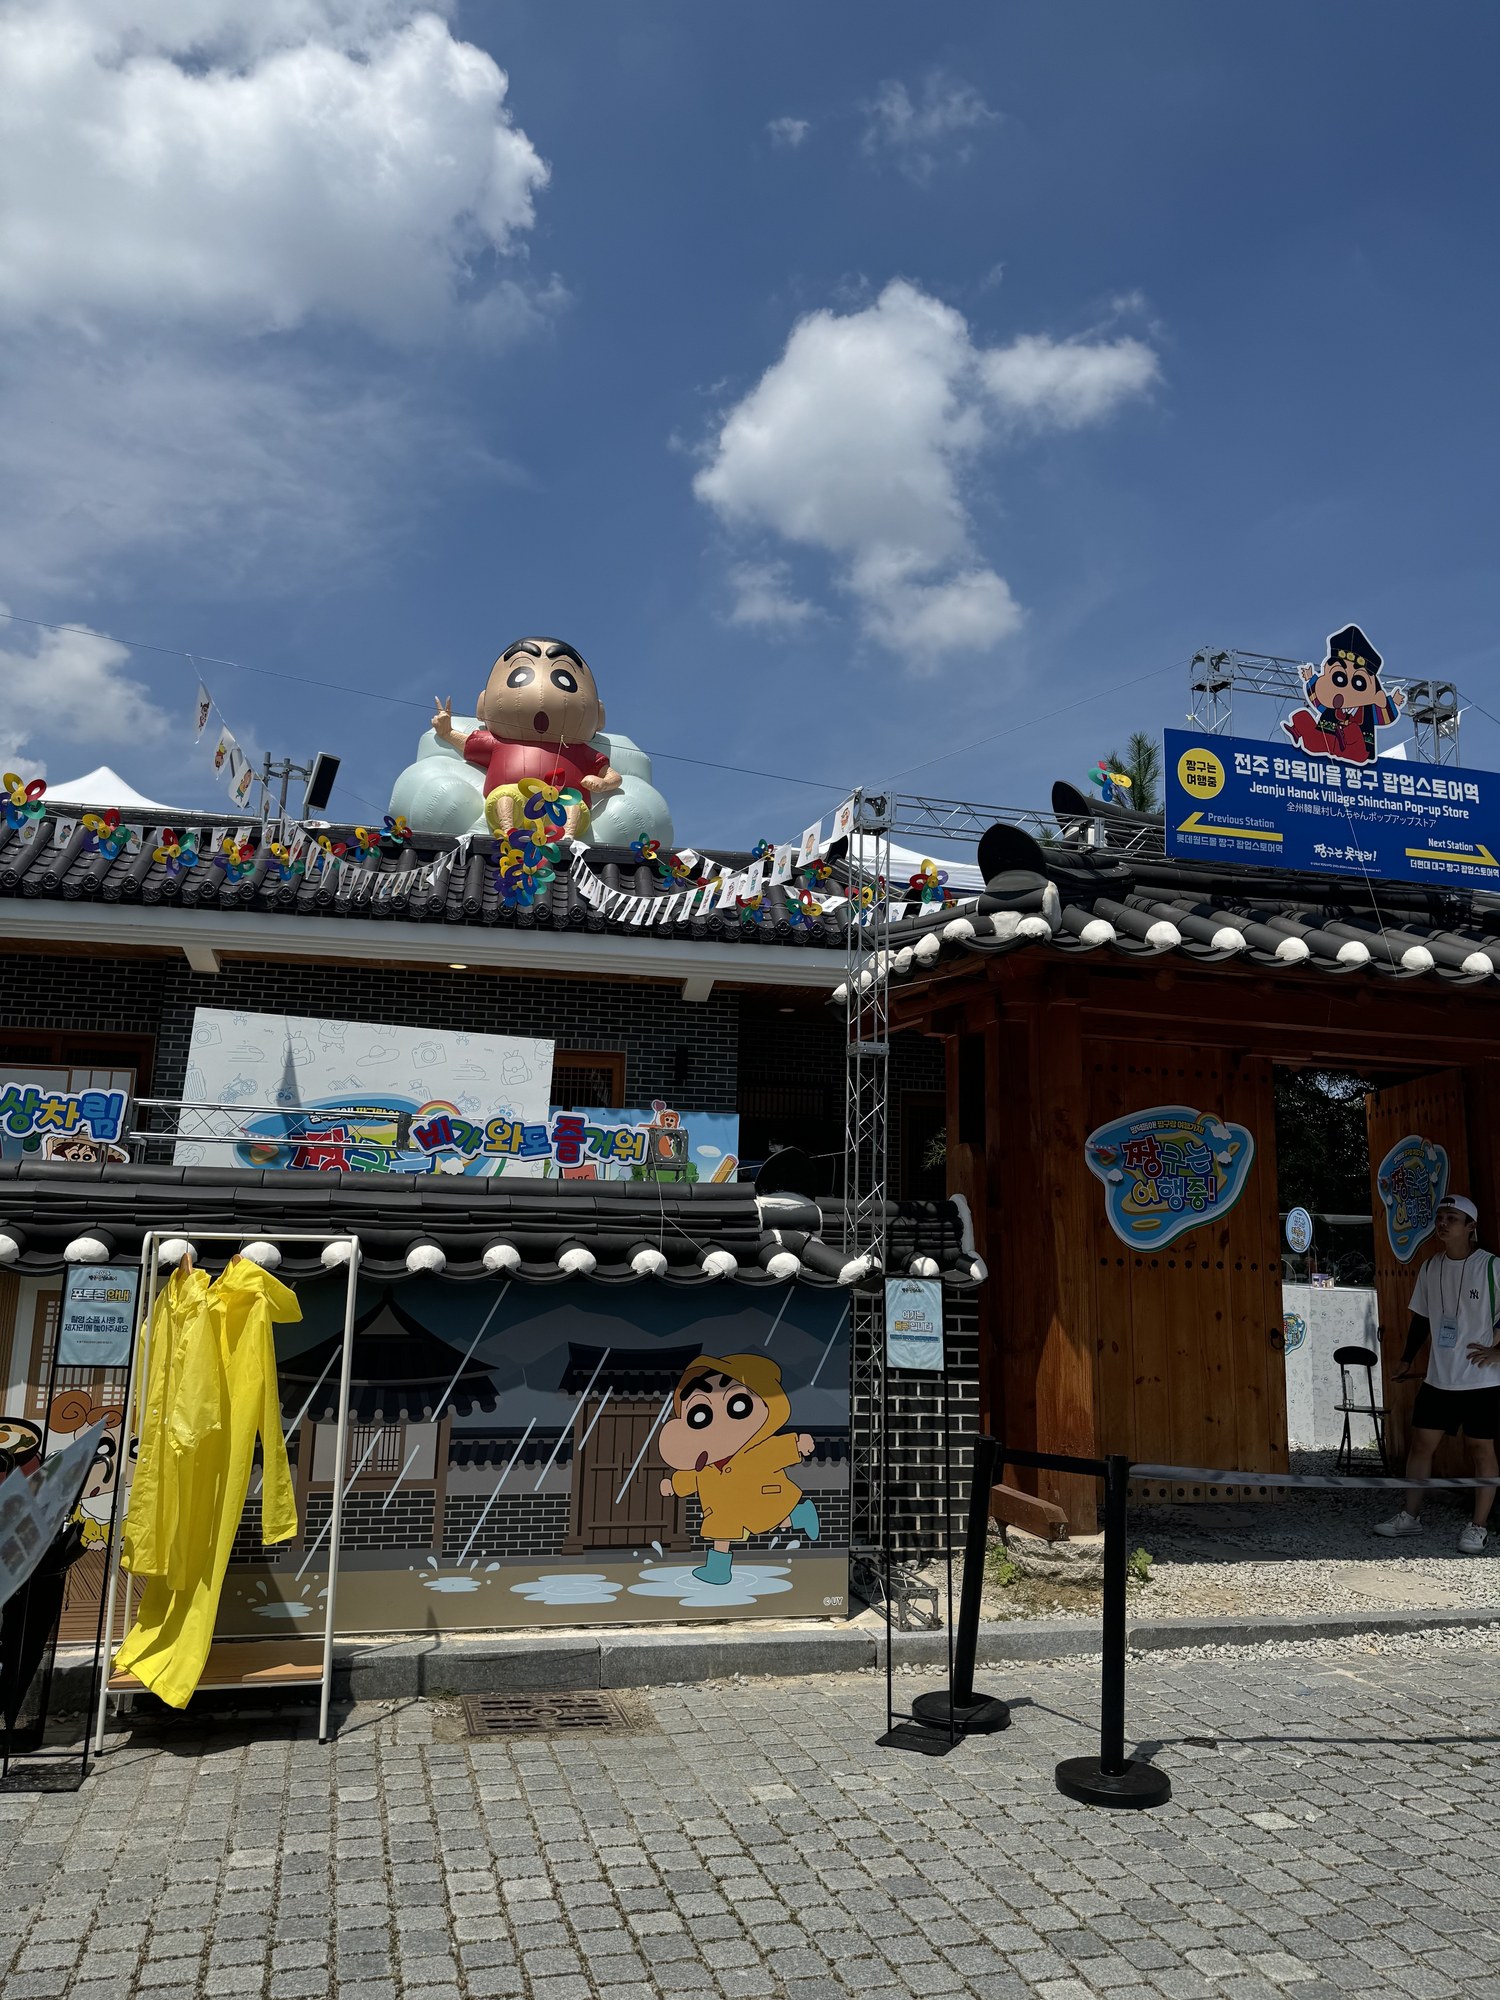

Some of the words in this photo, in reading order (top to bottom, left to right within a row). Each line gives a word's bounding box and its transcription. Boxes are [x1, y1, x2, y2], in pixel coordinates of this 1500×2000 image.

[1185, 759, 1217, 774] 짱구는
[1186, 774, 1217, 788] 여행중
[1234, 752, 1270, 777] 전주
[1273, 757, 1342, 787] 한옥마을
[1345, 767, 1379, 791] 짱구
[1382, 771, 1480, 804] 팝업스토어역
[1250, 781, 1285, 798] Jeonju
[1287, 785, 1320, 801] Hanok
[1321, 789, 1356, 807] Village
[1357, 794, 1403, 811] Shinchan
[1404, 799, 1441, 818] Pop-up
[1443, 805, 1470, 819] Store
[1208, 812, 1244, 825] Previous
[1245, 816, 1275, 829] Station
[1218, 838, 1235, 848] 짱구
[1236, 840, 1283, 853] 팝업스토어역
[1313, 842, 1343, 859] 짱구는
[1344, 845, 1377, 862] 못말려!
[1428, 837, 1446, 849] Next
[1447, 840, 1474, 852] Station
[1410, 859, 1432, 871] 더현대
[1432, 860, 1446, 871] 대구
[1446, 862, 1460, 873] 짱구
[1461, 863, 1500, 878] 팝업스토어역
[0, 1087, 123, 1139] 상차림
[1121, 1135, 1213, 1178] 짱구는
[1132, 1176, 1217, 1211] 여행중!
[71, 1288, 105, 1303] 포토존
[106, 1288, 131, 1303] 안내
[902, 1309, 925, 1320] 여기는
